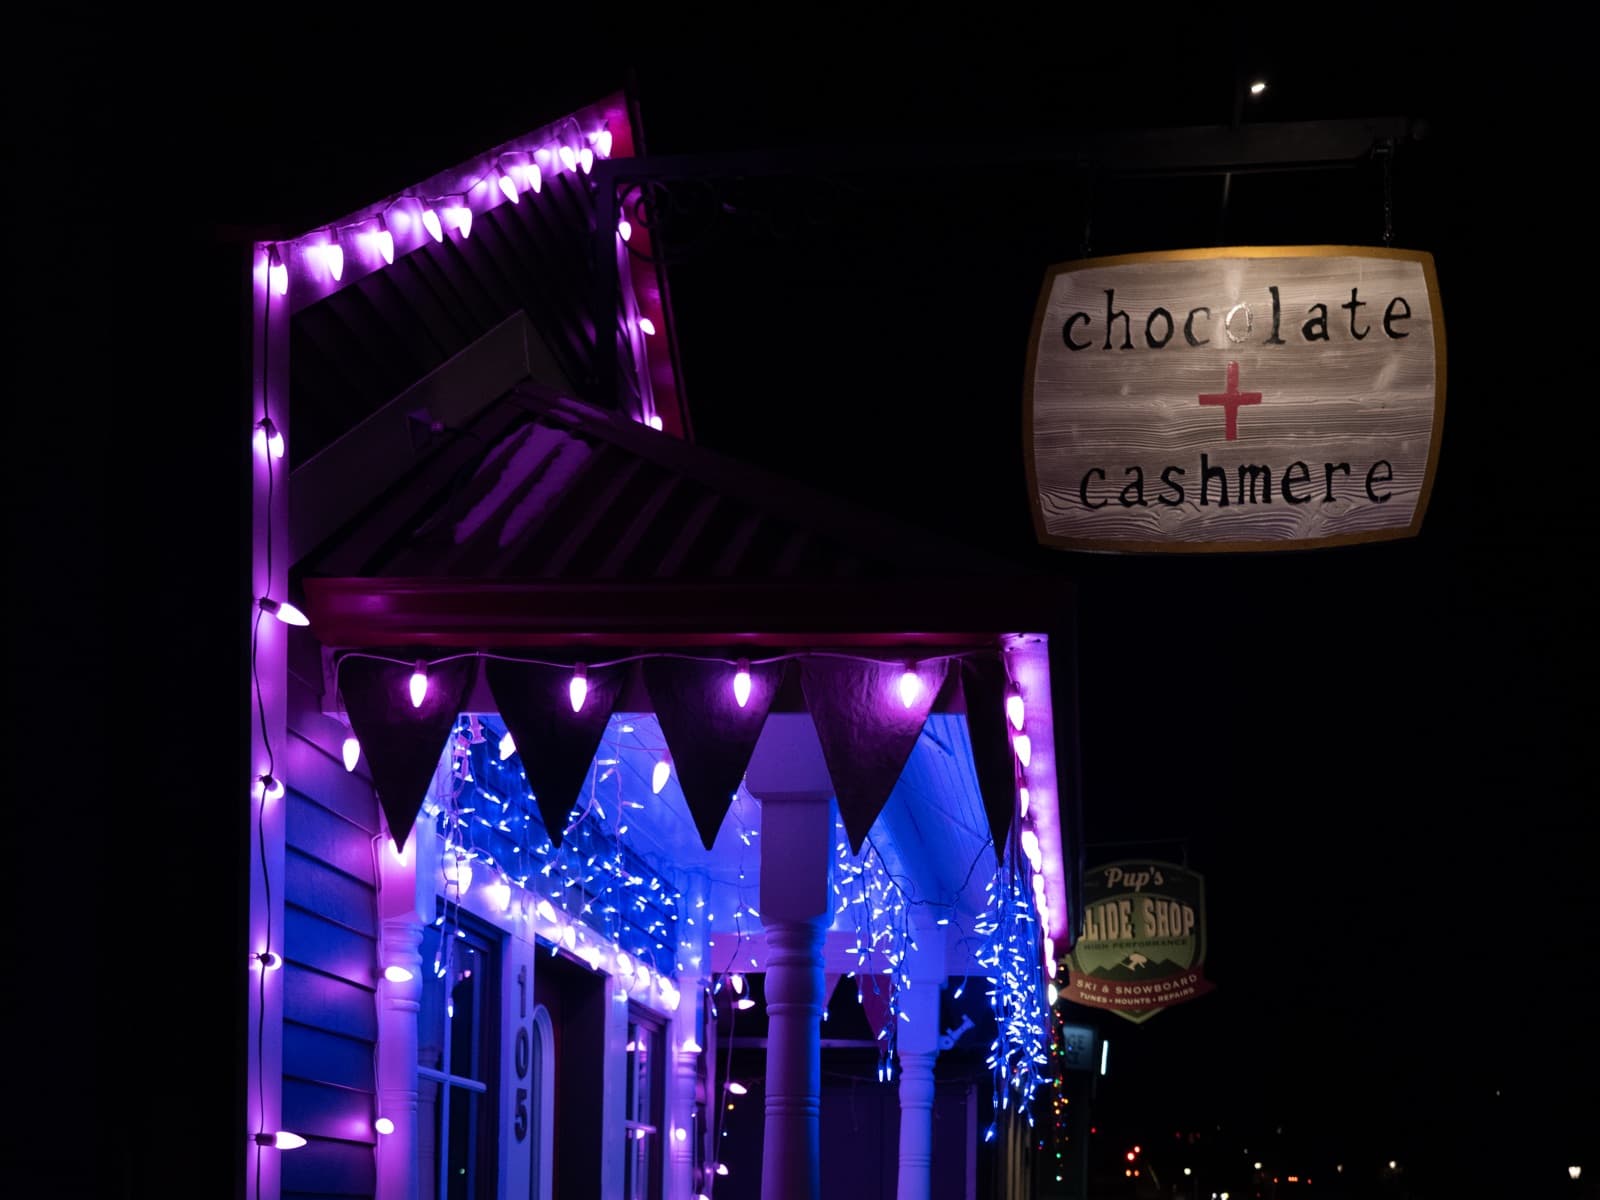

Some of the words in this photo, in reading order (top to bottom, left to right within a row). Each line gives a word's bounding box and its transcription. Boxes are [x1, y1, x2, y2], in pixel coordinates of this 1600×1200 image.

[1062, 285, 1412, 352] chocolate
[1079, 453, 1395, 509] cashmere
[1104, 866, 1164, 892] Pup's
[1079, 900, 1134, 941] LIDE
[1143, 897, 1195, 937] SHOP
[1076, 979, 1097, 992] SKI
[1115, 973, 1198, 995] SNOWBOARD
[1080, 991, 1108, 1003] TUNES
[1114, 996, 1151, 1005] MOUNTS
